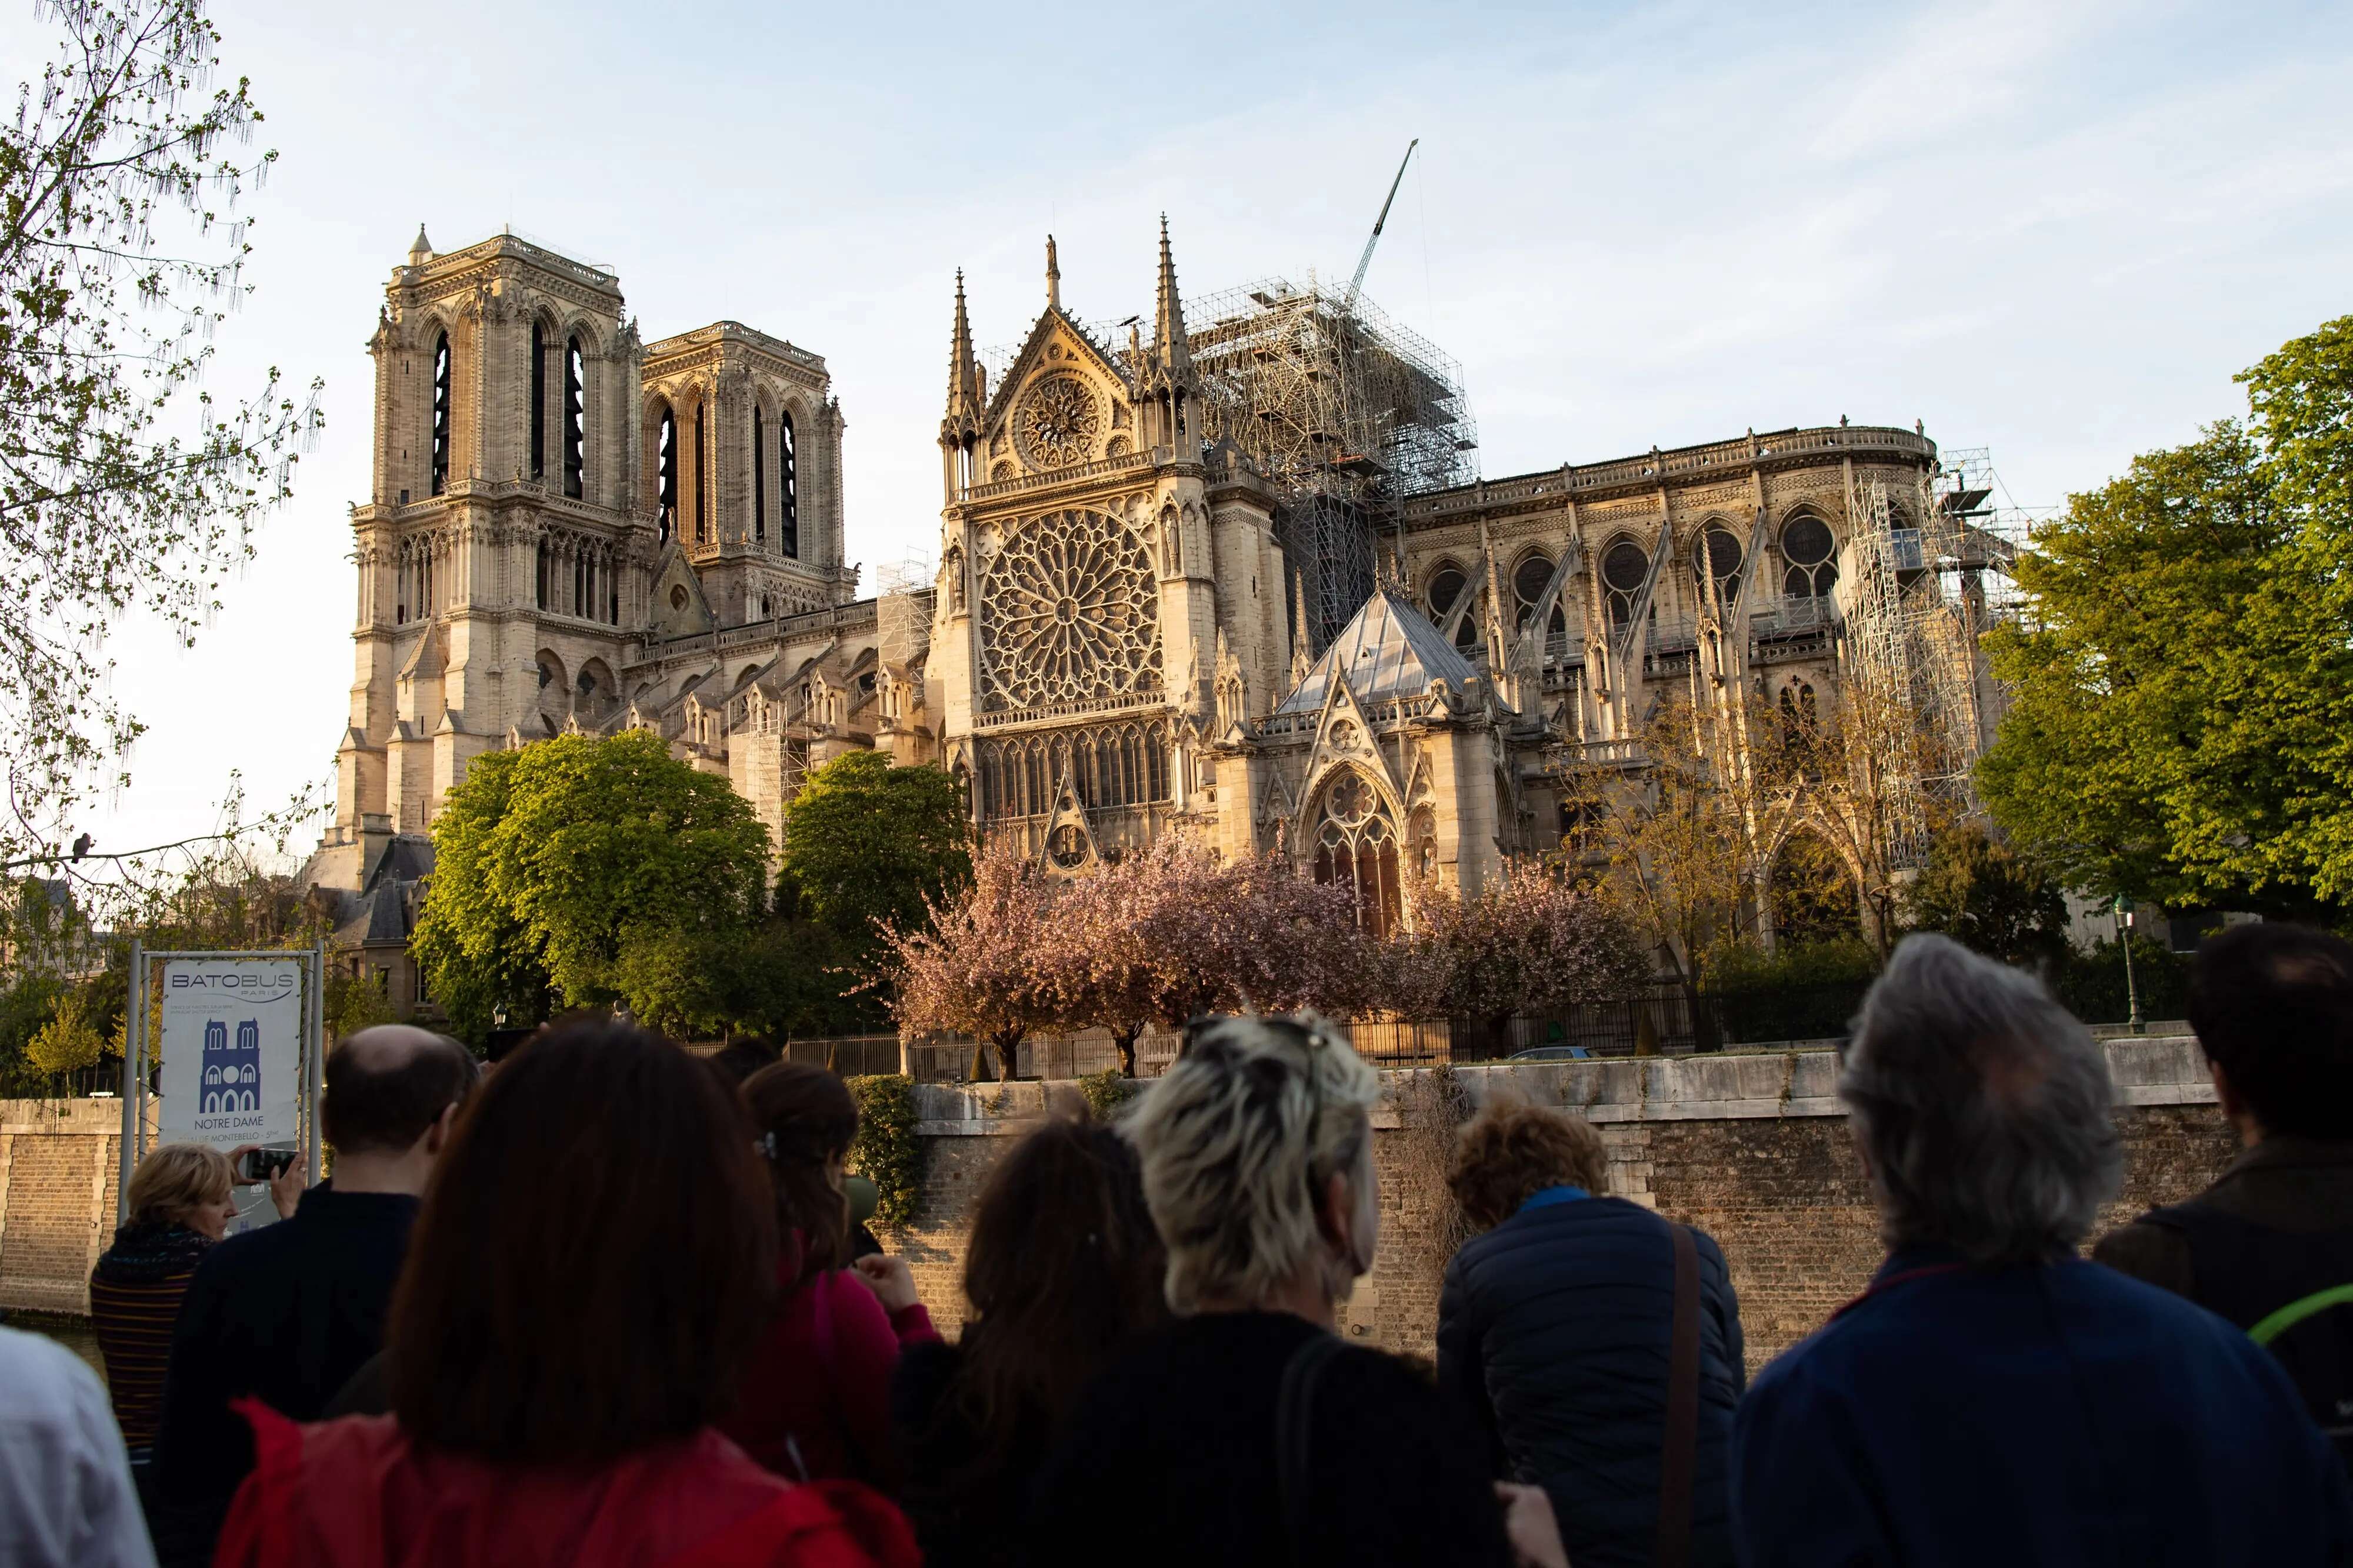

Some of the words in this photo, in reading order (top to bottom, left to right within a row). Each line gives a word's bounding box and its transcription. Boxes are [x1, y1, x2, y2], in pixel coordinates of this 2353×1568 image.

[172, 975, 293, 987] BATOBUS
[194, 1118, 230, 1129] NOTRE
[234, 1116, 264, 1127] DAME
[211, 1132, 259, 1143] MONTEBELLO
